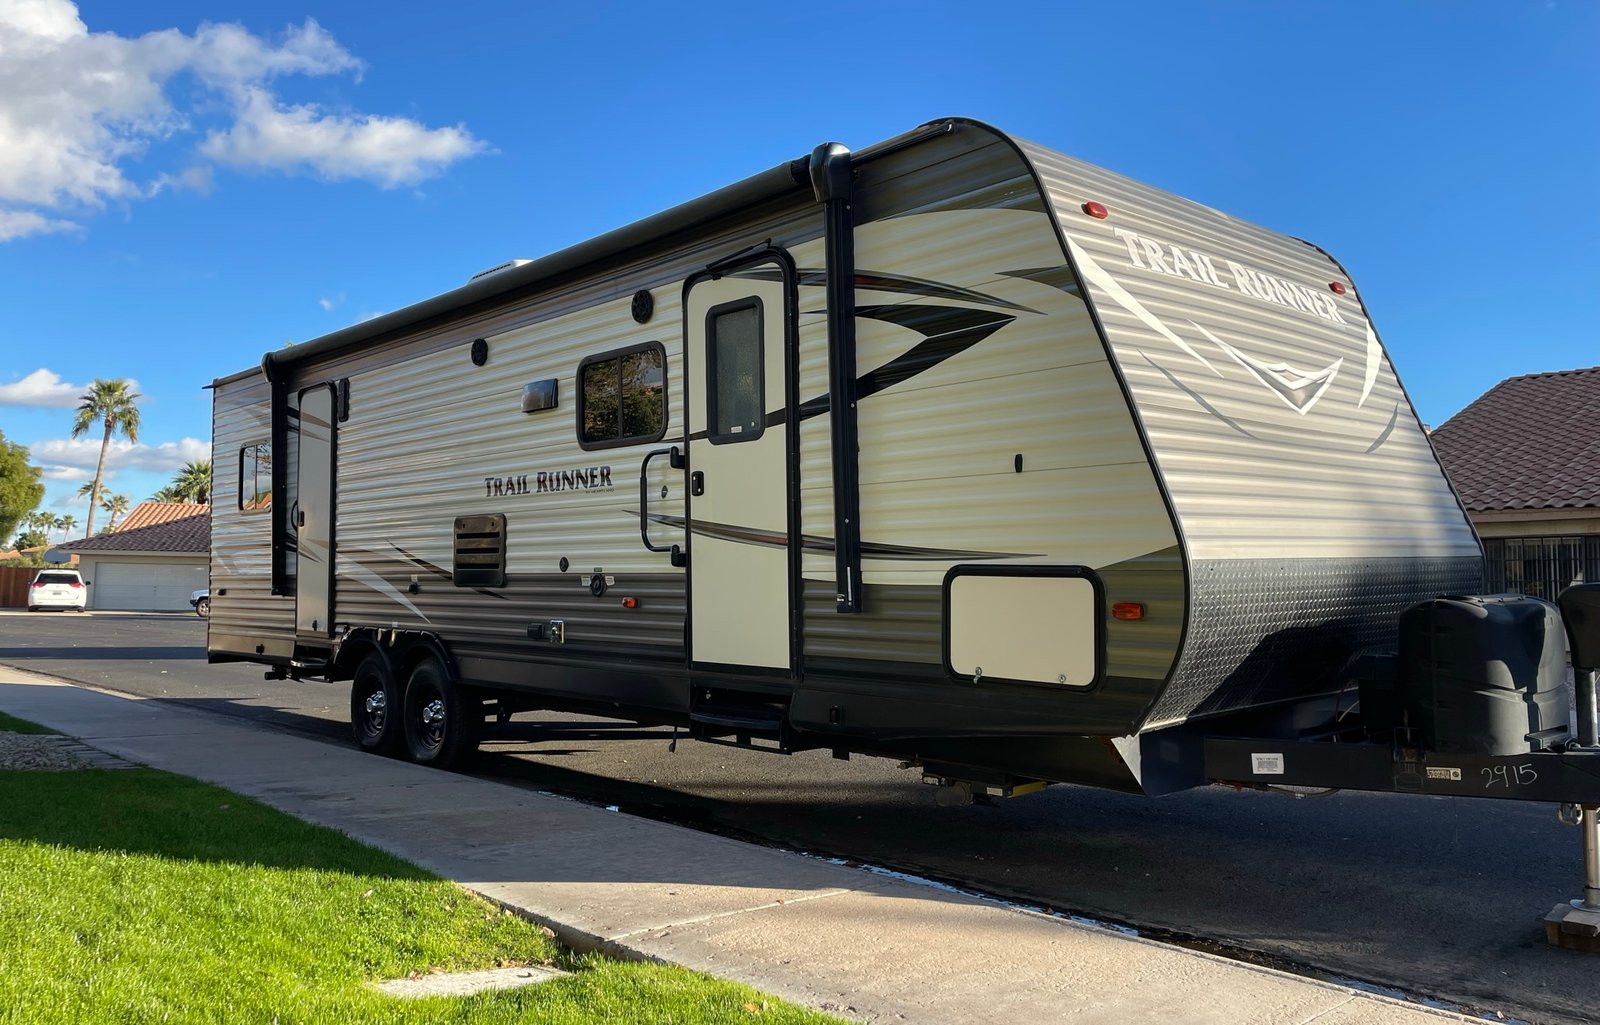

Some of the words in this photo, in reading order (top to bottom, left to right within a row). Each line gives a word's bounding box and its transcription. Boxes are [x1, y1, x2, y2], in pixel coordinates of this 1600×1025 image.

[1113, 226, 1230, 289] TRAIL
[1225, 259, 1347, 324] RUNNER
[484, 475, 530, 497] TRAIL
[536, 465, 613, 493] RUNNER
[1480, 763, 1538, 788] 2915
